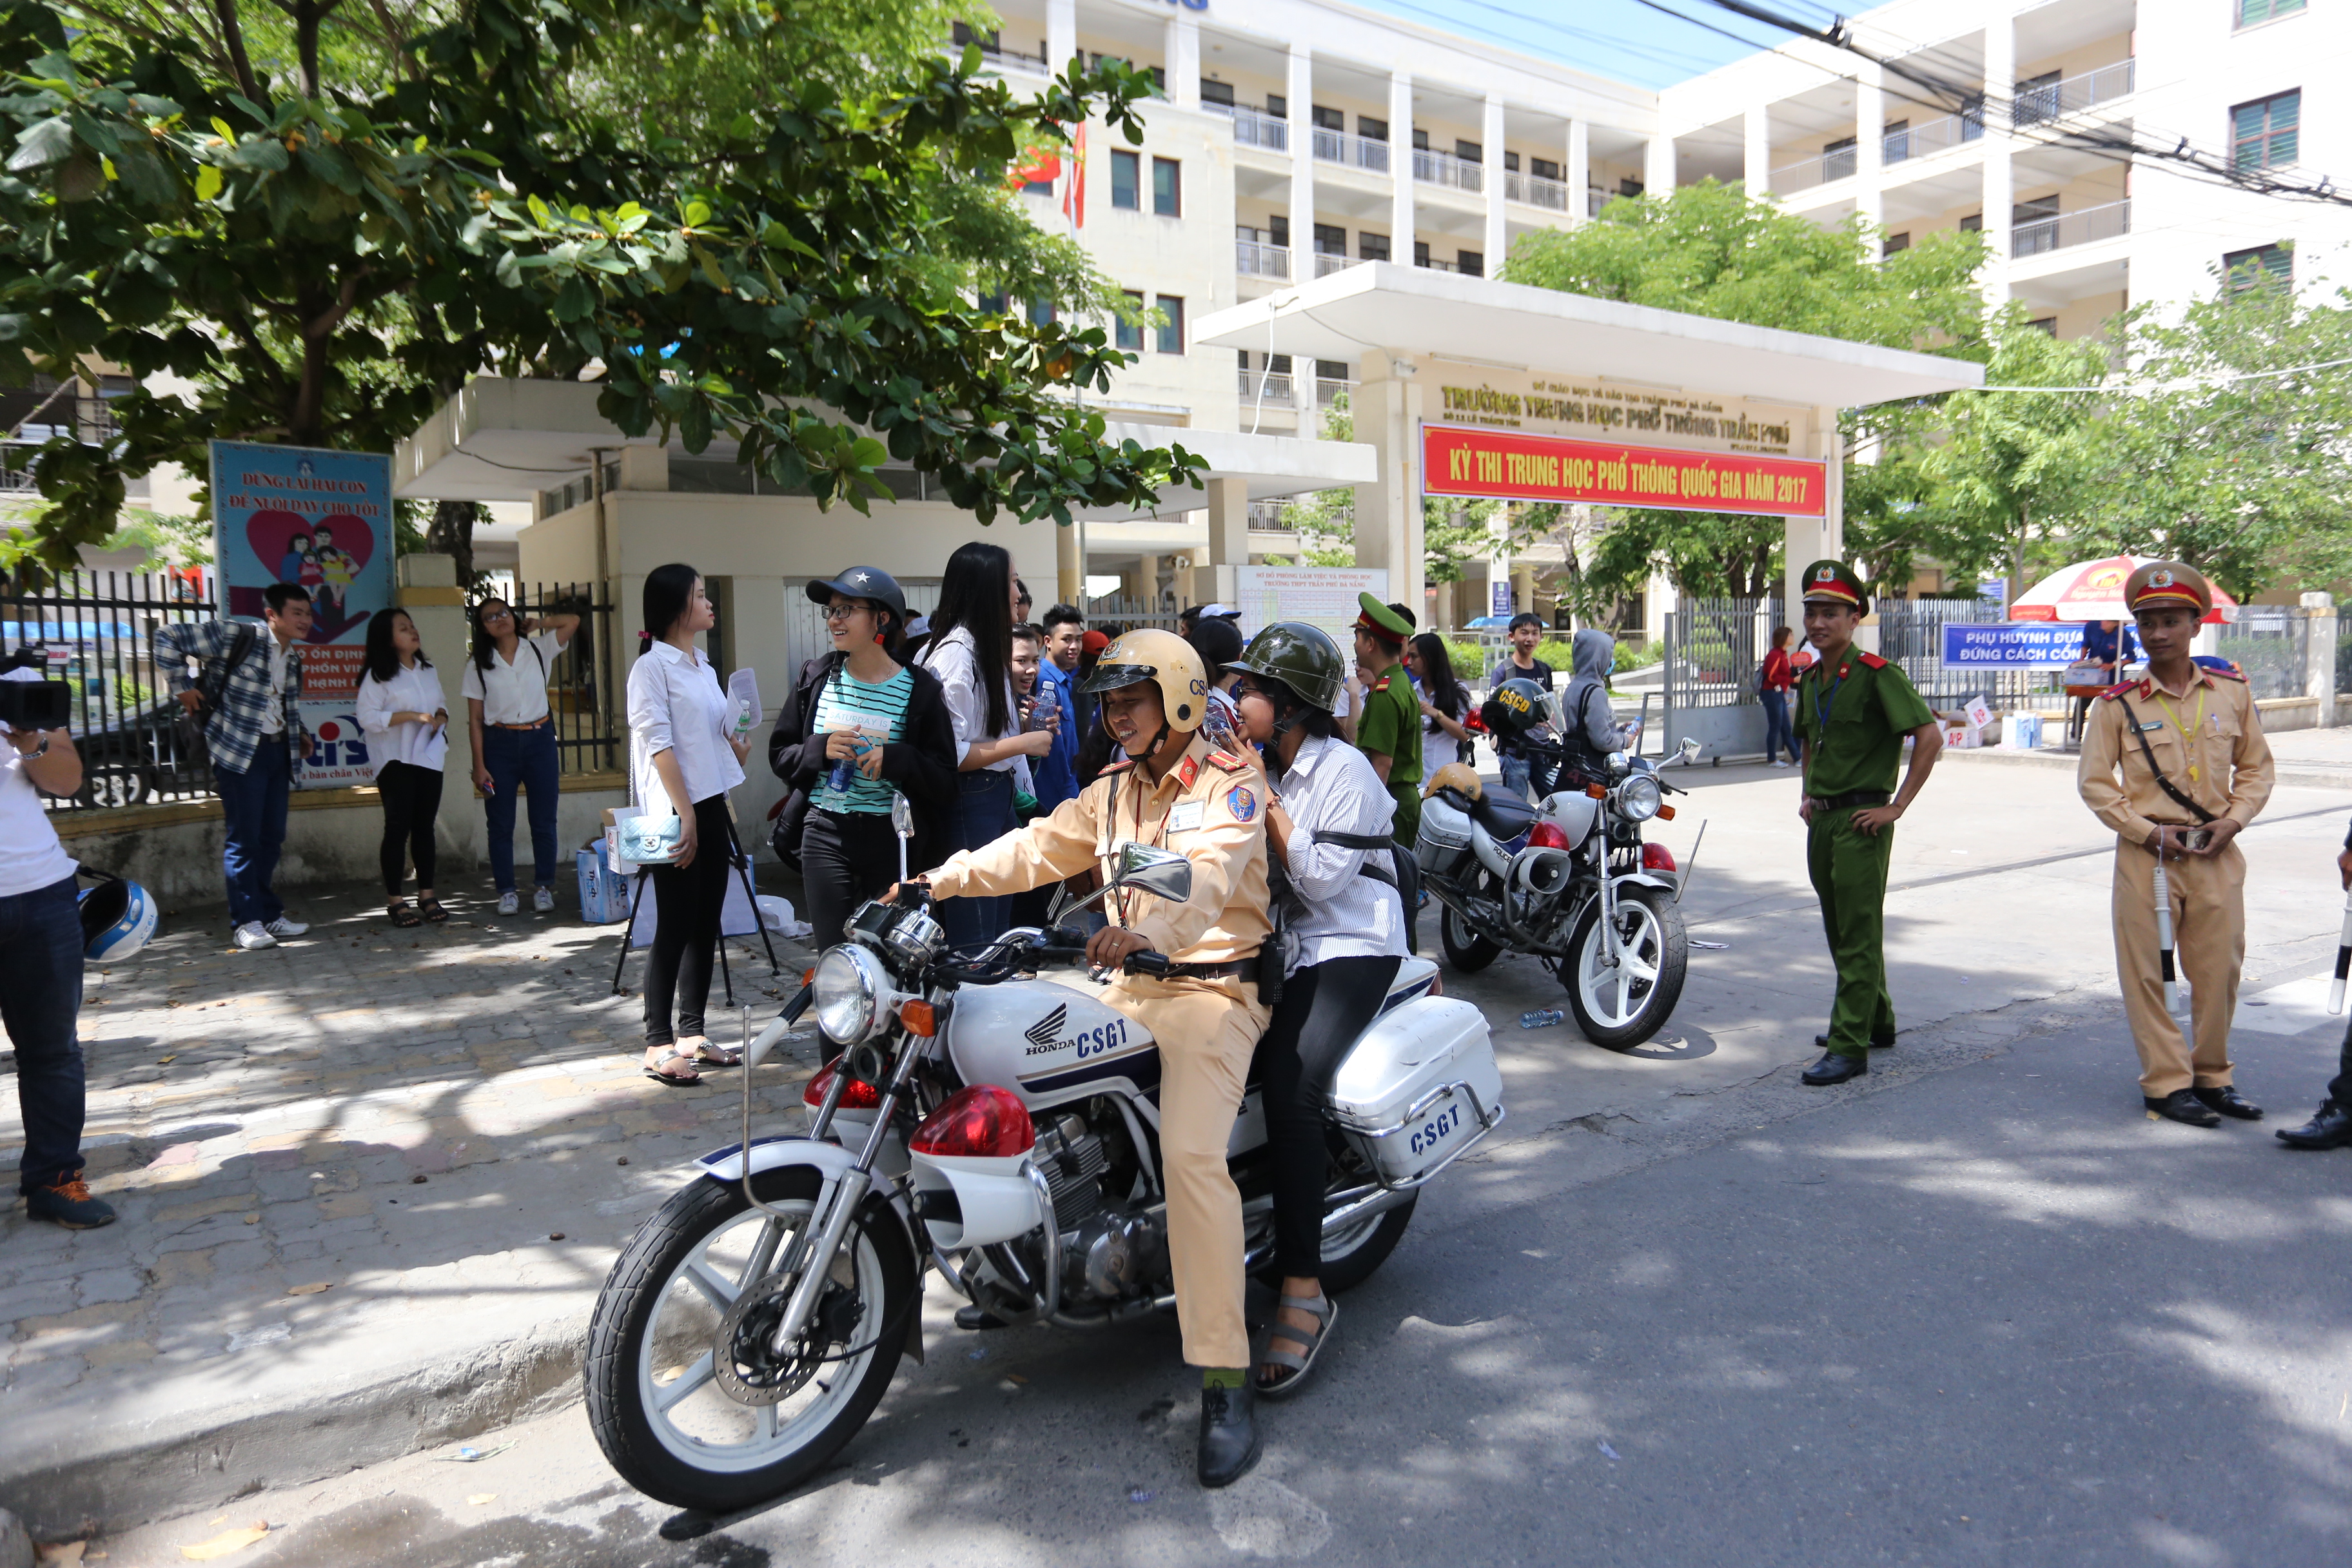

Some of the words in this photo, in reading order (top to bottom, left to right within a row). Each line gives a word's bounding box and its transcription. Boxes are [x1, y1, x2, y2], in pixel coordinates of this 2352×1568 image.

[1442, 383, 1522, 416] TRƯỜNG
[1524, 395, 1585, 423] TRUNG
[1587, 403, 1624, 432] HỌC
[1664, 410, 1717, 438] THÔNG
[1718, 411, 1759, 442] TRẦN
[1760, 420, 1790, 446] PHÚ
[1449, 442, 1472, 481] KỲ
[1476, 450, 1502, 483] THI
[1506, 453, 1559, 487] TRUNG
[1563, 457, 1594, 495] HỌC
[1597, 451, 1629, 492] PHỔ
[1631, 458, 1678, 495] THÔNG
[1681, 459, 1717, 499] QUỐC
[1720, 470, 1742, 500] GIA
[1745, 467, 1775, 502] NĂM
[1777, 475, 1808, 504] 2017
[311, 478, 338, 493] HAI
[338, 480, 368, 495] CON
[253, 495, 290, 513] NUÔI
[322, 501, 352, 516] CHO
[1966, 632, 1997, 646] PHỤ
[1999, 632, 2050, 644] HUYNH
[2053, 631, 2084, 644] ĐƯA
[1959, 645, 2001, 661] ĐỨNG
[2004, 645, 2047, 661] CÁCH
[2049, 643, 2082, 661] CỔN
[343, 664, 363, 672] VIN
[1190, 679, 1208, 697] CS
[1499, 690, 1531, 712] CSCD
[829, 711, 877, 725] SATURDAY
[309, 769, 328, 779] bàn
[329, 769, 353, 779] chân
[355, 767, 374, 779] Việt
[1493, 845, 1512, 863] POLICE
[1025, 1039, 1076, 1055] HONDA
[1077, 1018, 1127, 1059] CSGT
[1410, 1103, 1458, 1155] CSGT
